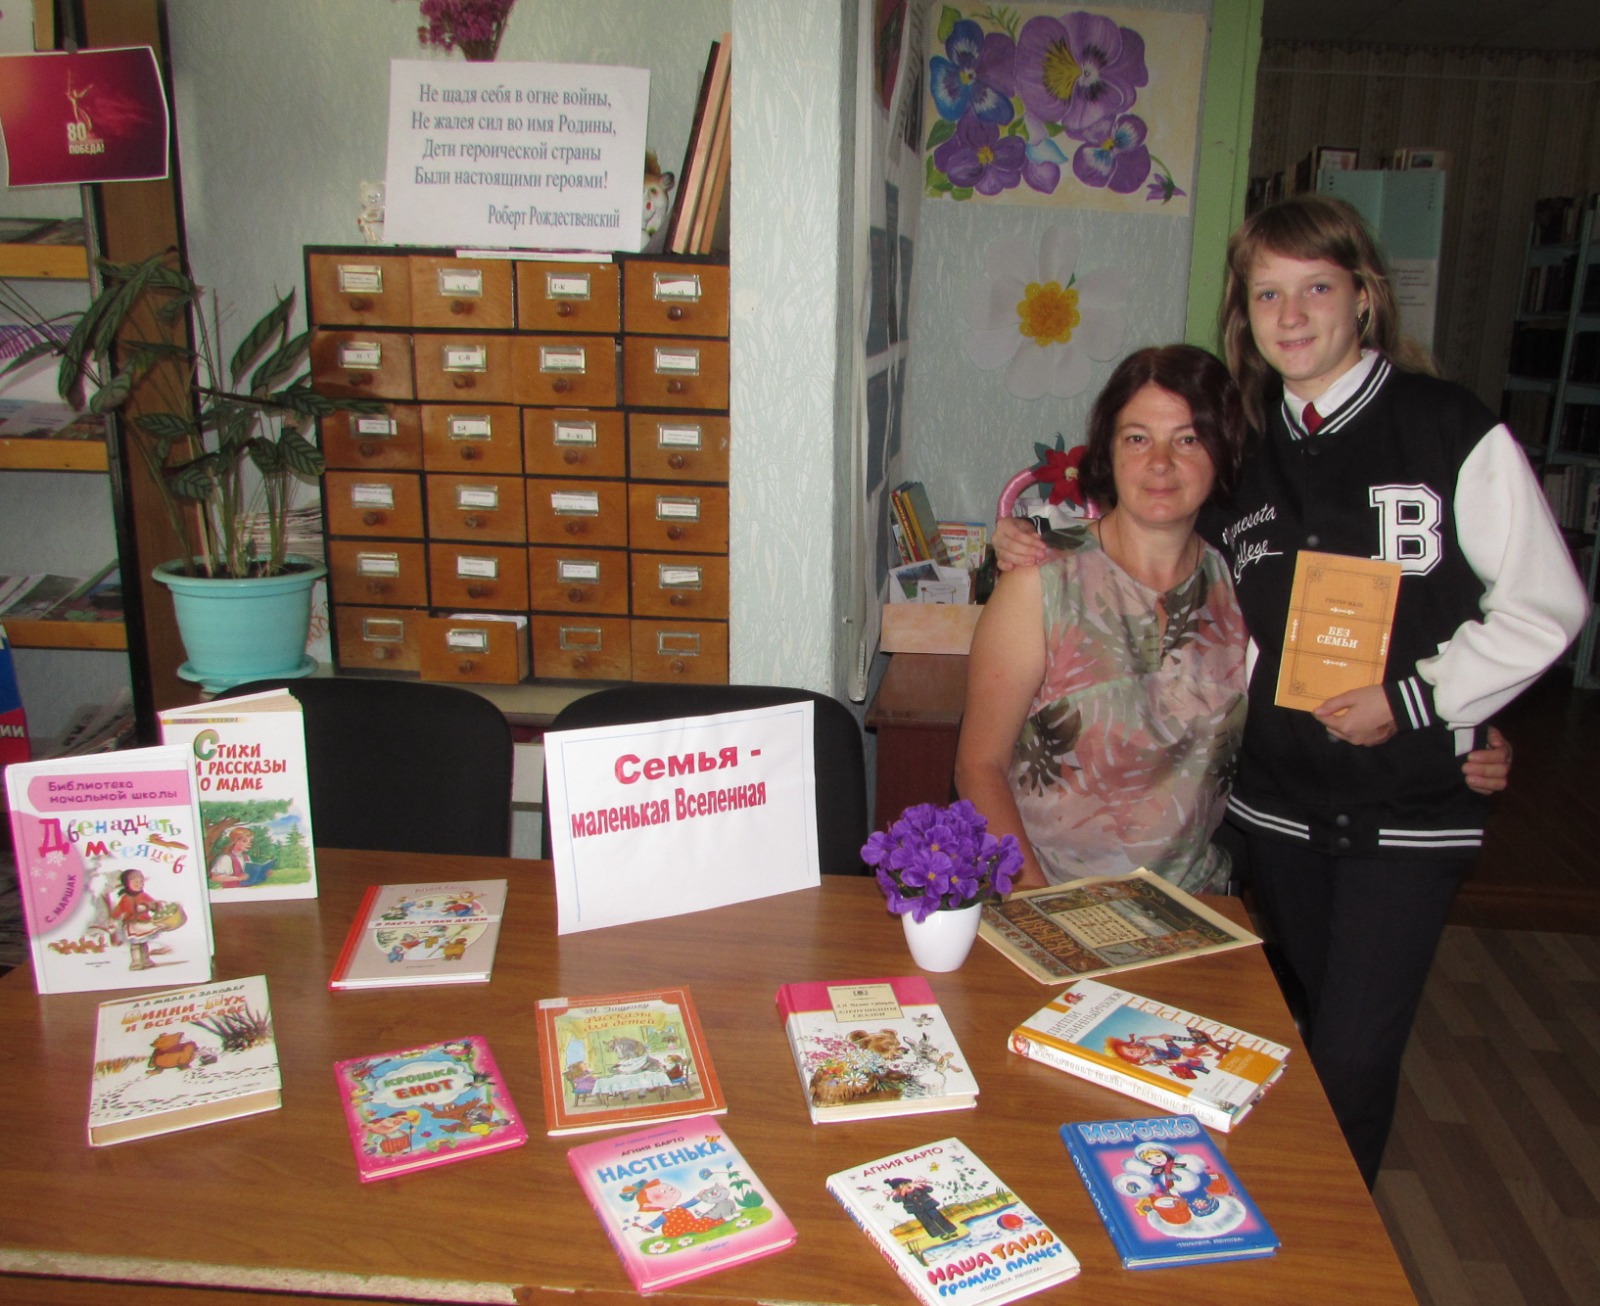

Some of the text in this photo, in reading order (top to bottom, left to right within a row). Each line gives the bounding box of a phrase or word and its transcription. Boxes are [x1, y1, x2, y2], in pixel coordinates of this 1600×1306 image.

[420, 84, 612, 109] Не щадя себя в огне войны,
[67, 122, 87, 141] 80
[411, 111, 617, 136] Не жалея сил во имя Родины,
[69, 144, 105, 154] ПОБЕДА!
[422, 139, 601, 165] Дети героической страны
[415, 166, 608, 192] Были настоящими героями!
[488, 204, 620, 230] Роберт Рождественский
[1222, 503, 1277, 546] Mnesota
[1368, 483, 1442, 576] B
[1316, 635, 1358, 649] СЕМЬИ
[1328, 626, 1351, 637] БЕЗ
[208, 760, 286, 775] РАССКАЗЫ
[615, 746, 738, 785] Семья
[49, 780, 134, 792] Библиотека
[50, 790, 177, 804] начальной школы
[200, 776, 263, 792] О МАМЕ
[571, 782, 766, 838] маленькая Вселенная
[38, 815, 182, 858] Двенадцать
[85, 838, 187, 875] месяцев
[54, 874, 77, 917] МАРШАК
[125, 1023, 137, 1033] И
[584, 1023, 608, 1032] для
[1046, 1010, 1082, 1036] ПИППИ
[1124, 996, 1284, 1056] ЛИНДГРЕН
[383, 1066, 459, 1088] КРОШКА
[394, 1078, 454, 1099] ЕНОТ
[1078, 1116, 1200, 1145] МОРОЗКО
[621, 1145, 652, 1157] АГНИЯ
[654, 1136, 685, 1148] БАРТО
[596, 1141, 726, 1184] НАСТЕНЬКА
[863, 1147, 943, 1177] АГНИЯ БАРТО
[927, 1230, 1054, 1285] НАША ТАНЯ
[938, 1243, 1063, 1297] ГРОМКО ПЛАЧЕТ
